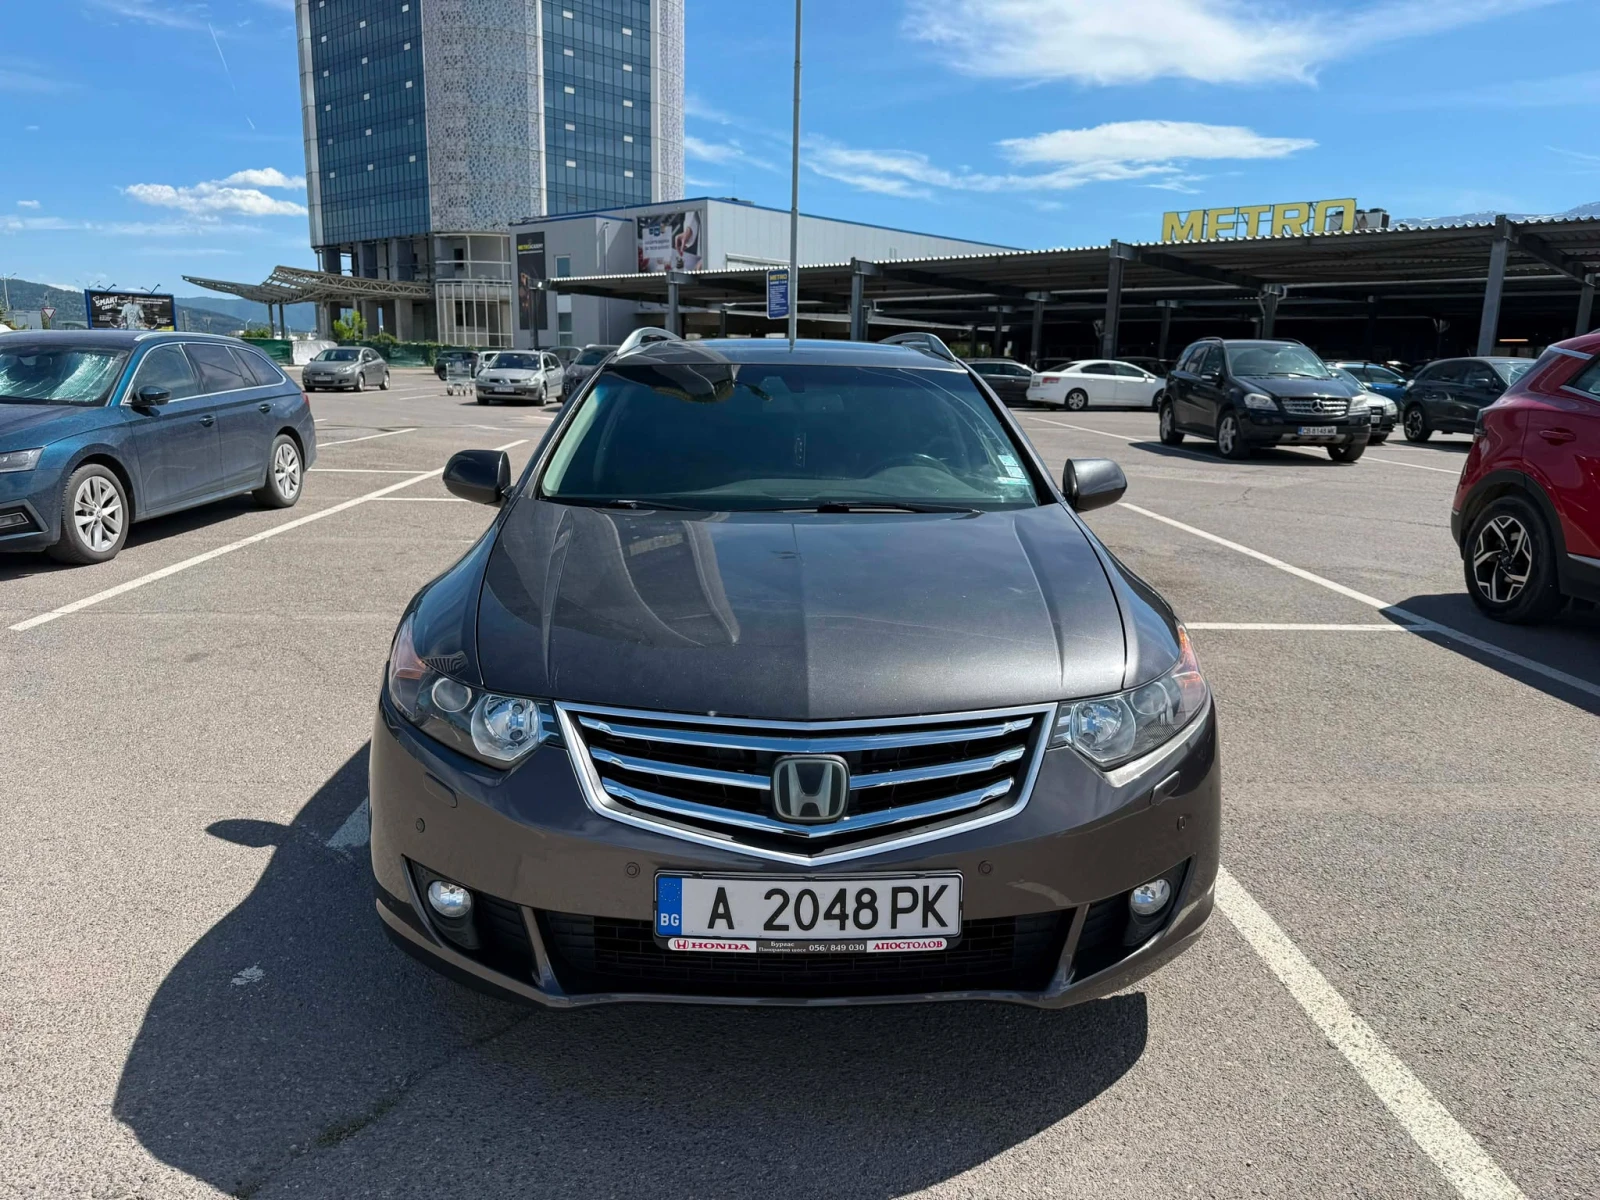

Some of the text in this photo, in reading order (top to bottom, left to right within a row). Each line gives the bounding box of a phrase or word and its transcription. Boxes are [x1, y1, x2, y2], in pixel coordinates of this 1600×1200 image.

[1162, 198, 1357, 242] METRO
[95, 296, 118, 307] SMART
[707, 884, 949, 931] A 2048 PK
[660, 912, 680, 927] BG
[808, 943, 865, 952] 056/ 849 030
[873, 941, 943, 950] АПОСТОЛОВ
